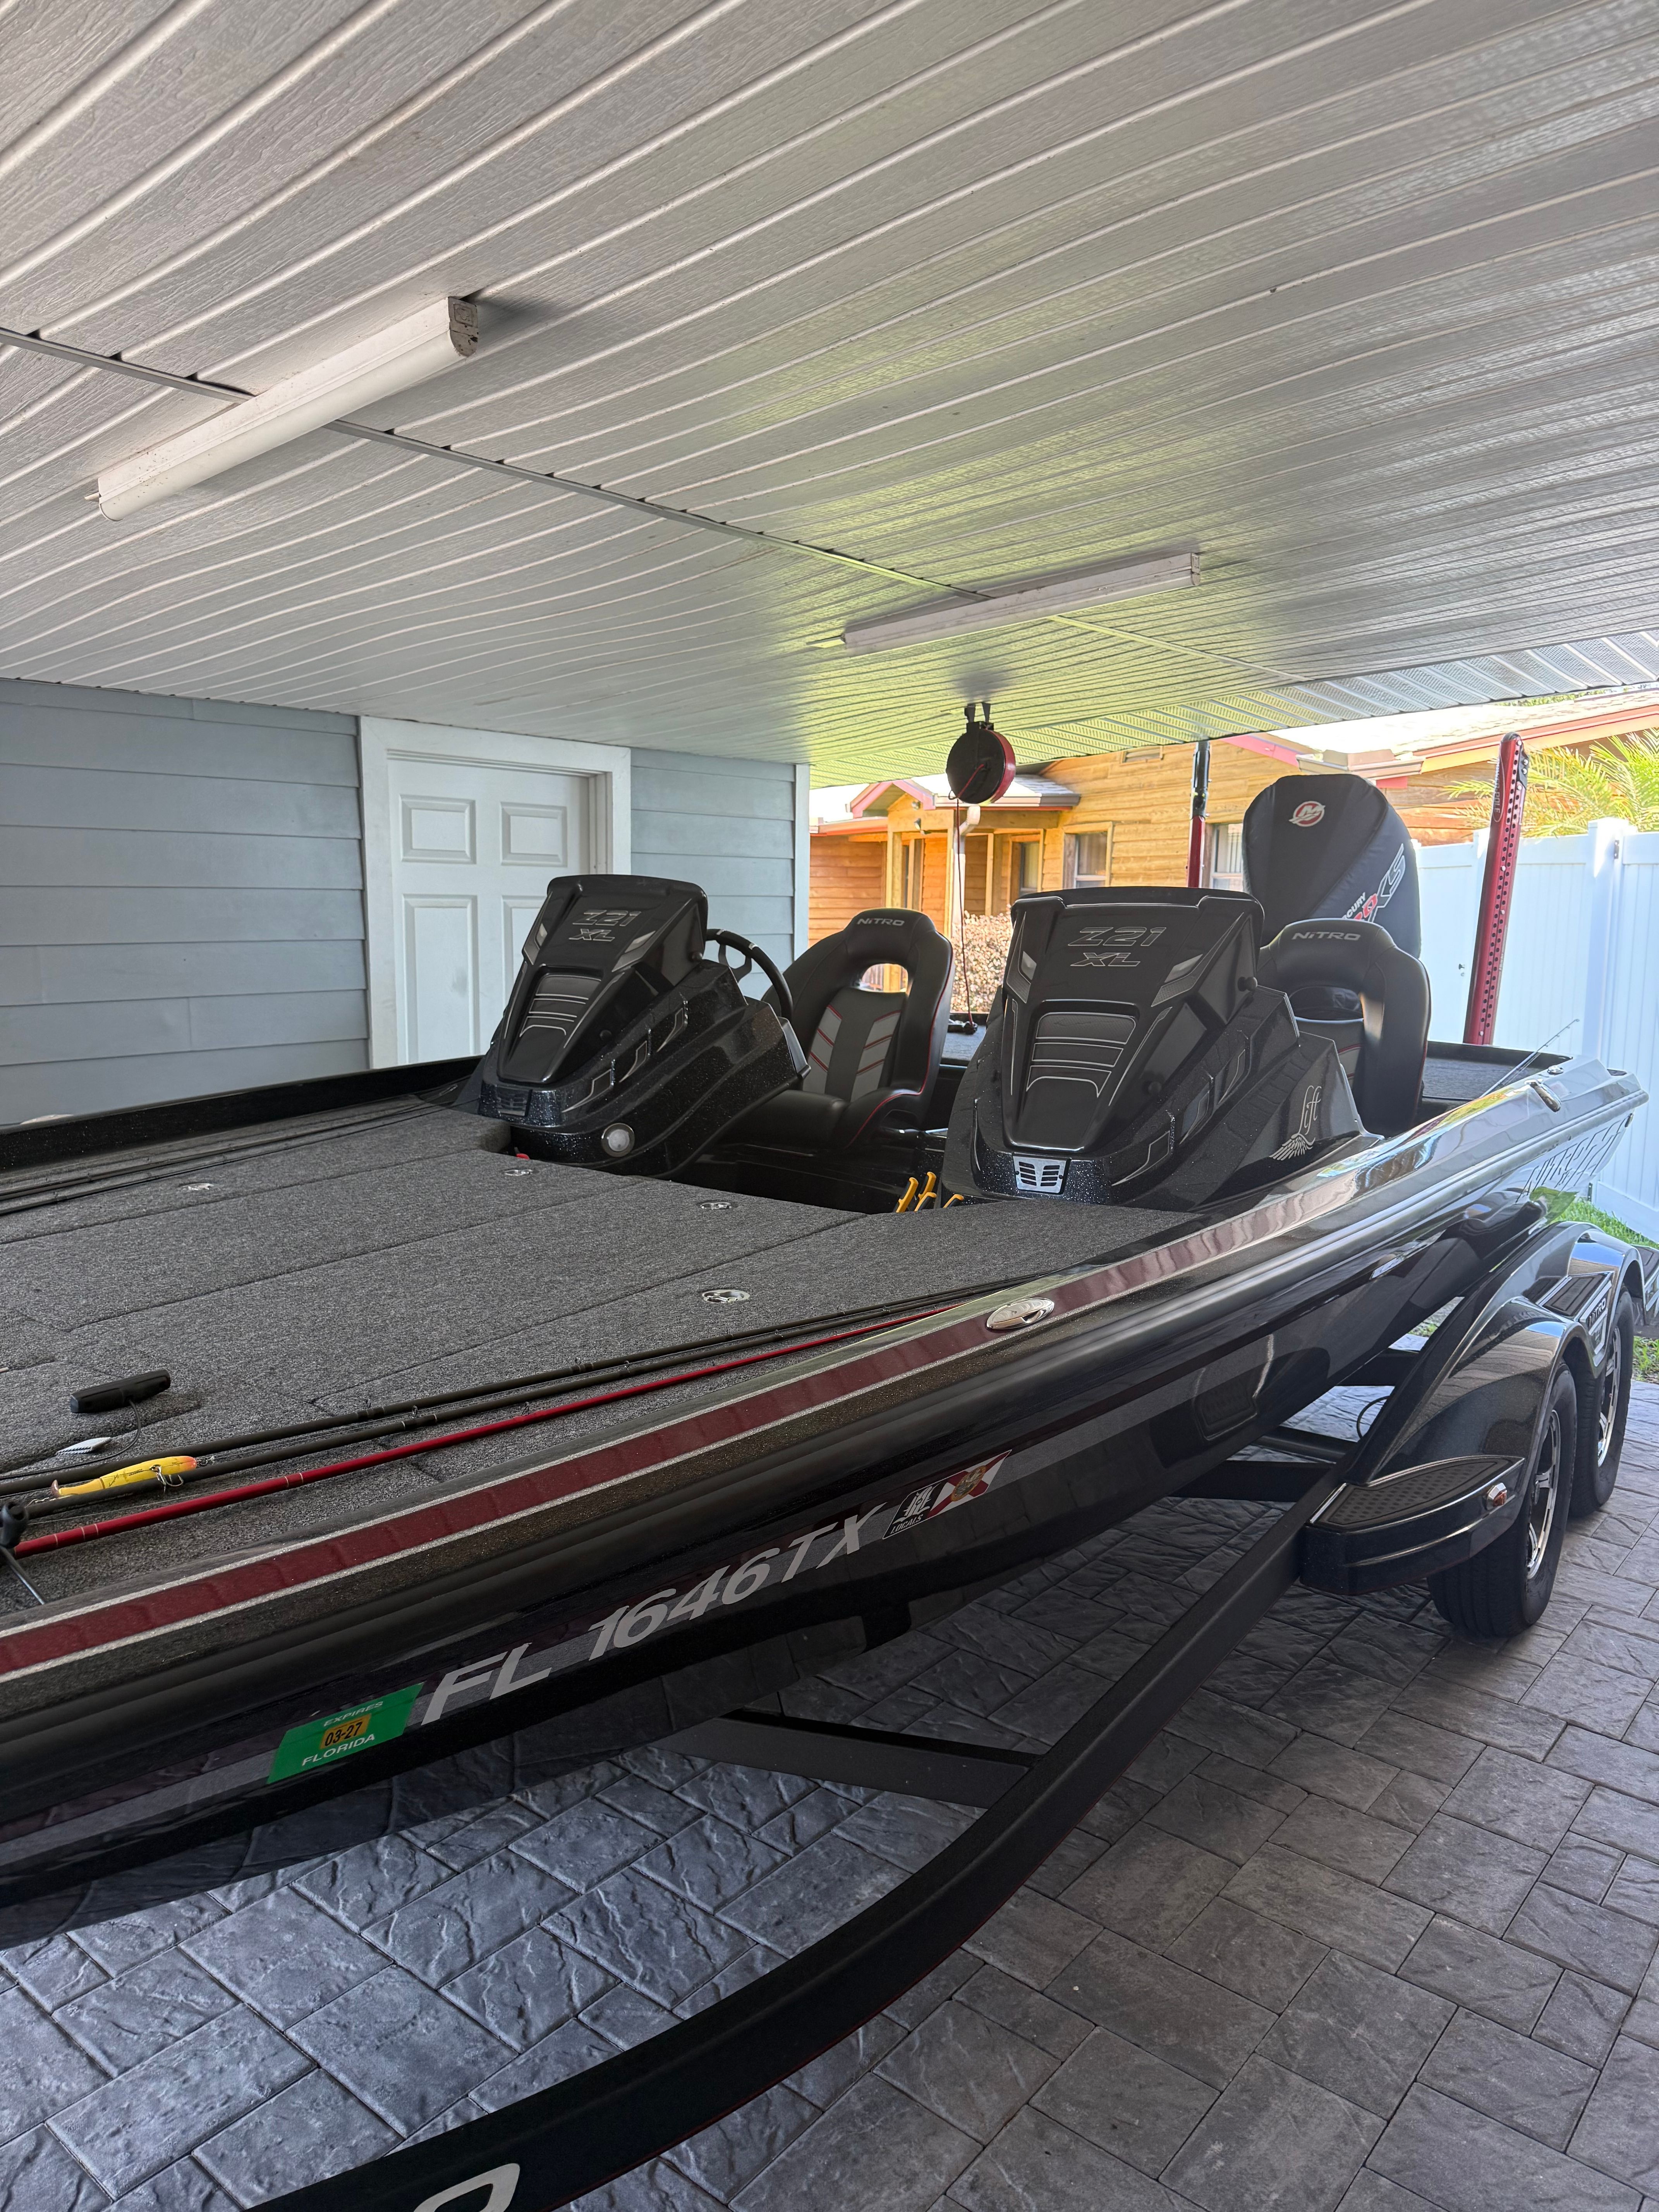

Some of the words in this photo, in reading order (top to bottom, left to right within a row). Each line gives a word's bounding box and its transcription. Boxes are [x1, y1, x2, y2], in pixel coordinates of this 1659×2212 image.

[572, 910, 641, 926] Z21
[568, 929, 615, 941] XL
[1068, 927, 1166, 946] Z21
[1070, 952, 1140, 966] XL
[891, 1514, 924, 1534] LOCALS
[421, 1642, 552, 1726] FL
[324, 1701, 383, 1727] EXPIRES
[325, 1721, 363, 1747] 03-27
[302, 1733, 376, 1766] FLORIDA
